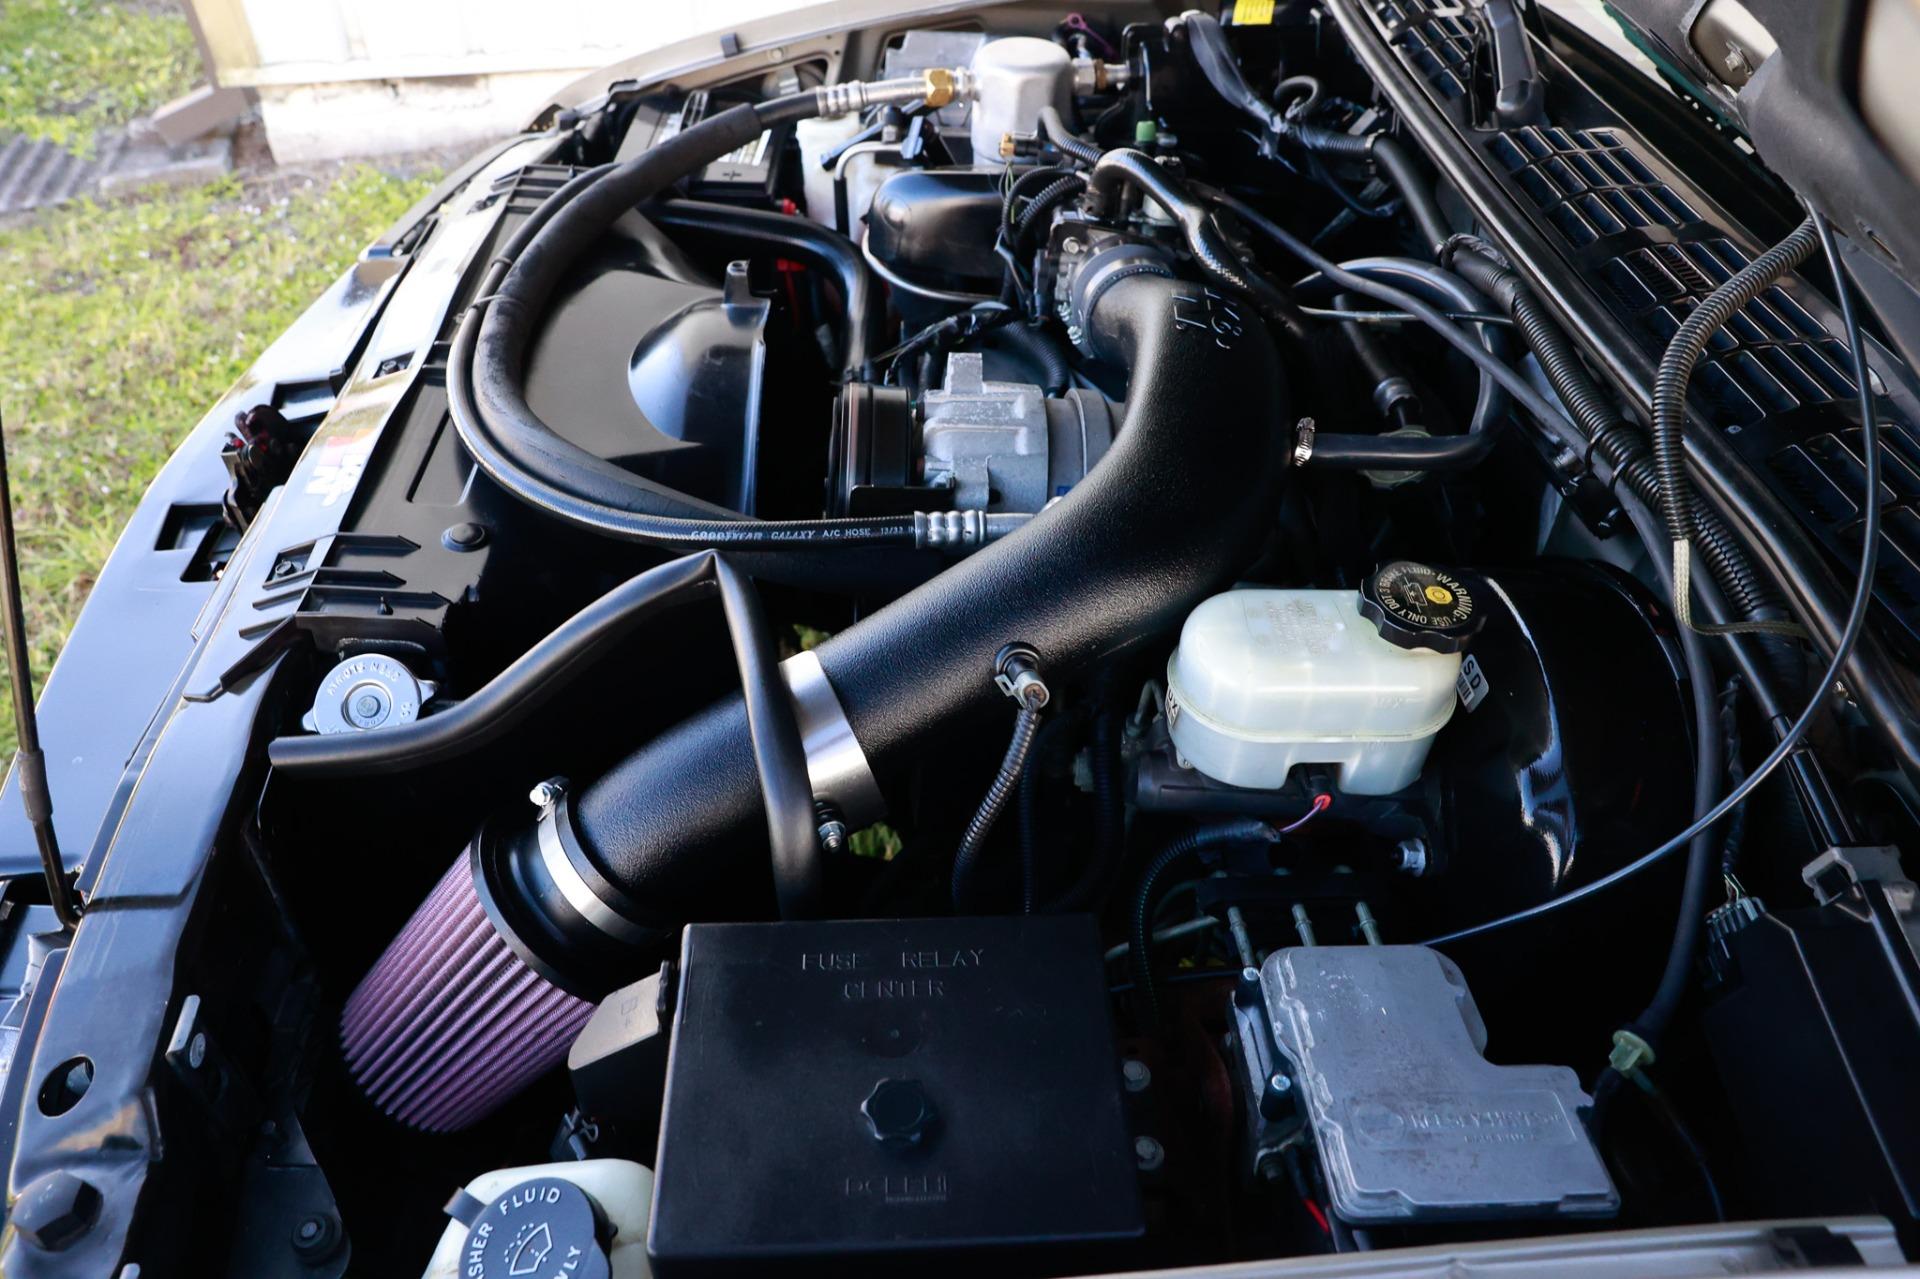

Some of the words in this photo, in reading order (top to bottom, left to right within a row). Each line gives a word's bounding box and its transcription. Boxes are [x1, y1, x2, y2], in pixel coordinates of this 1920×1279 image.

[690, 530, 763, 541] GOODYEAR
[771, 530, 816, 540] GALAXY
[822, 529, 841, 537] A/C
[846, 527, 871, 536] HOSE
[1380, 594, 1400, 610] DOT
[1436, 572, 1473, 620] WARNING
[1398, 608, 1428, 624] ONLY
[1431, 616, 1452, 627] USE
[802, 952, 867, 970] FUSE
[902, 949, 983, 968] RELAY
[844, 979, 944, 999] CENTER
[467, 1222, 494, 1279] SHER
[499, 1187, 561, 1216] FLUID
[553, 1245, 582, 1279] NLY
